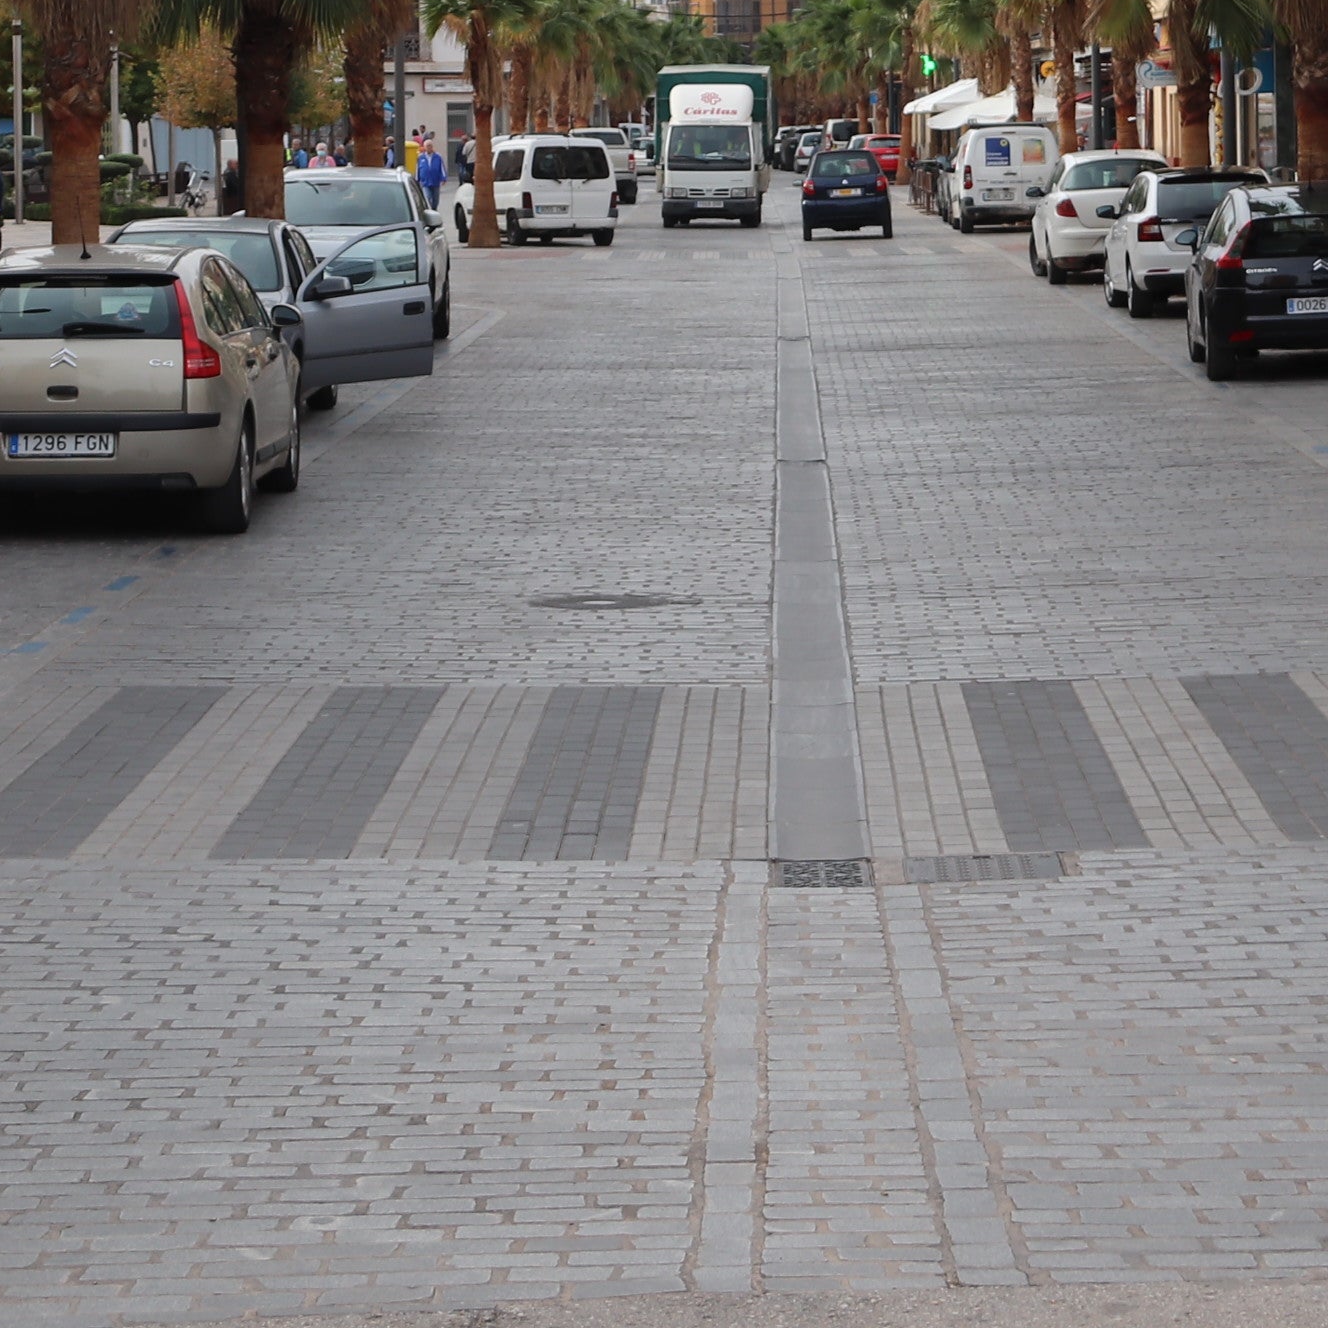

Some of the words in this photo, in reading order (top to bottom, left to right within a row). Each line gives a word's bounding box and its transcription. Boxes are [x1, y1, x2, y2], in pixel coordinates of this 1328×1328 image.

[1296, 299, 1327, 312] 0026
[148, 357, 175, 368] C4
[22, 435, 68, 452] 1296
[74, 434, 110, 451] FGN
